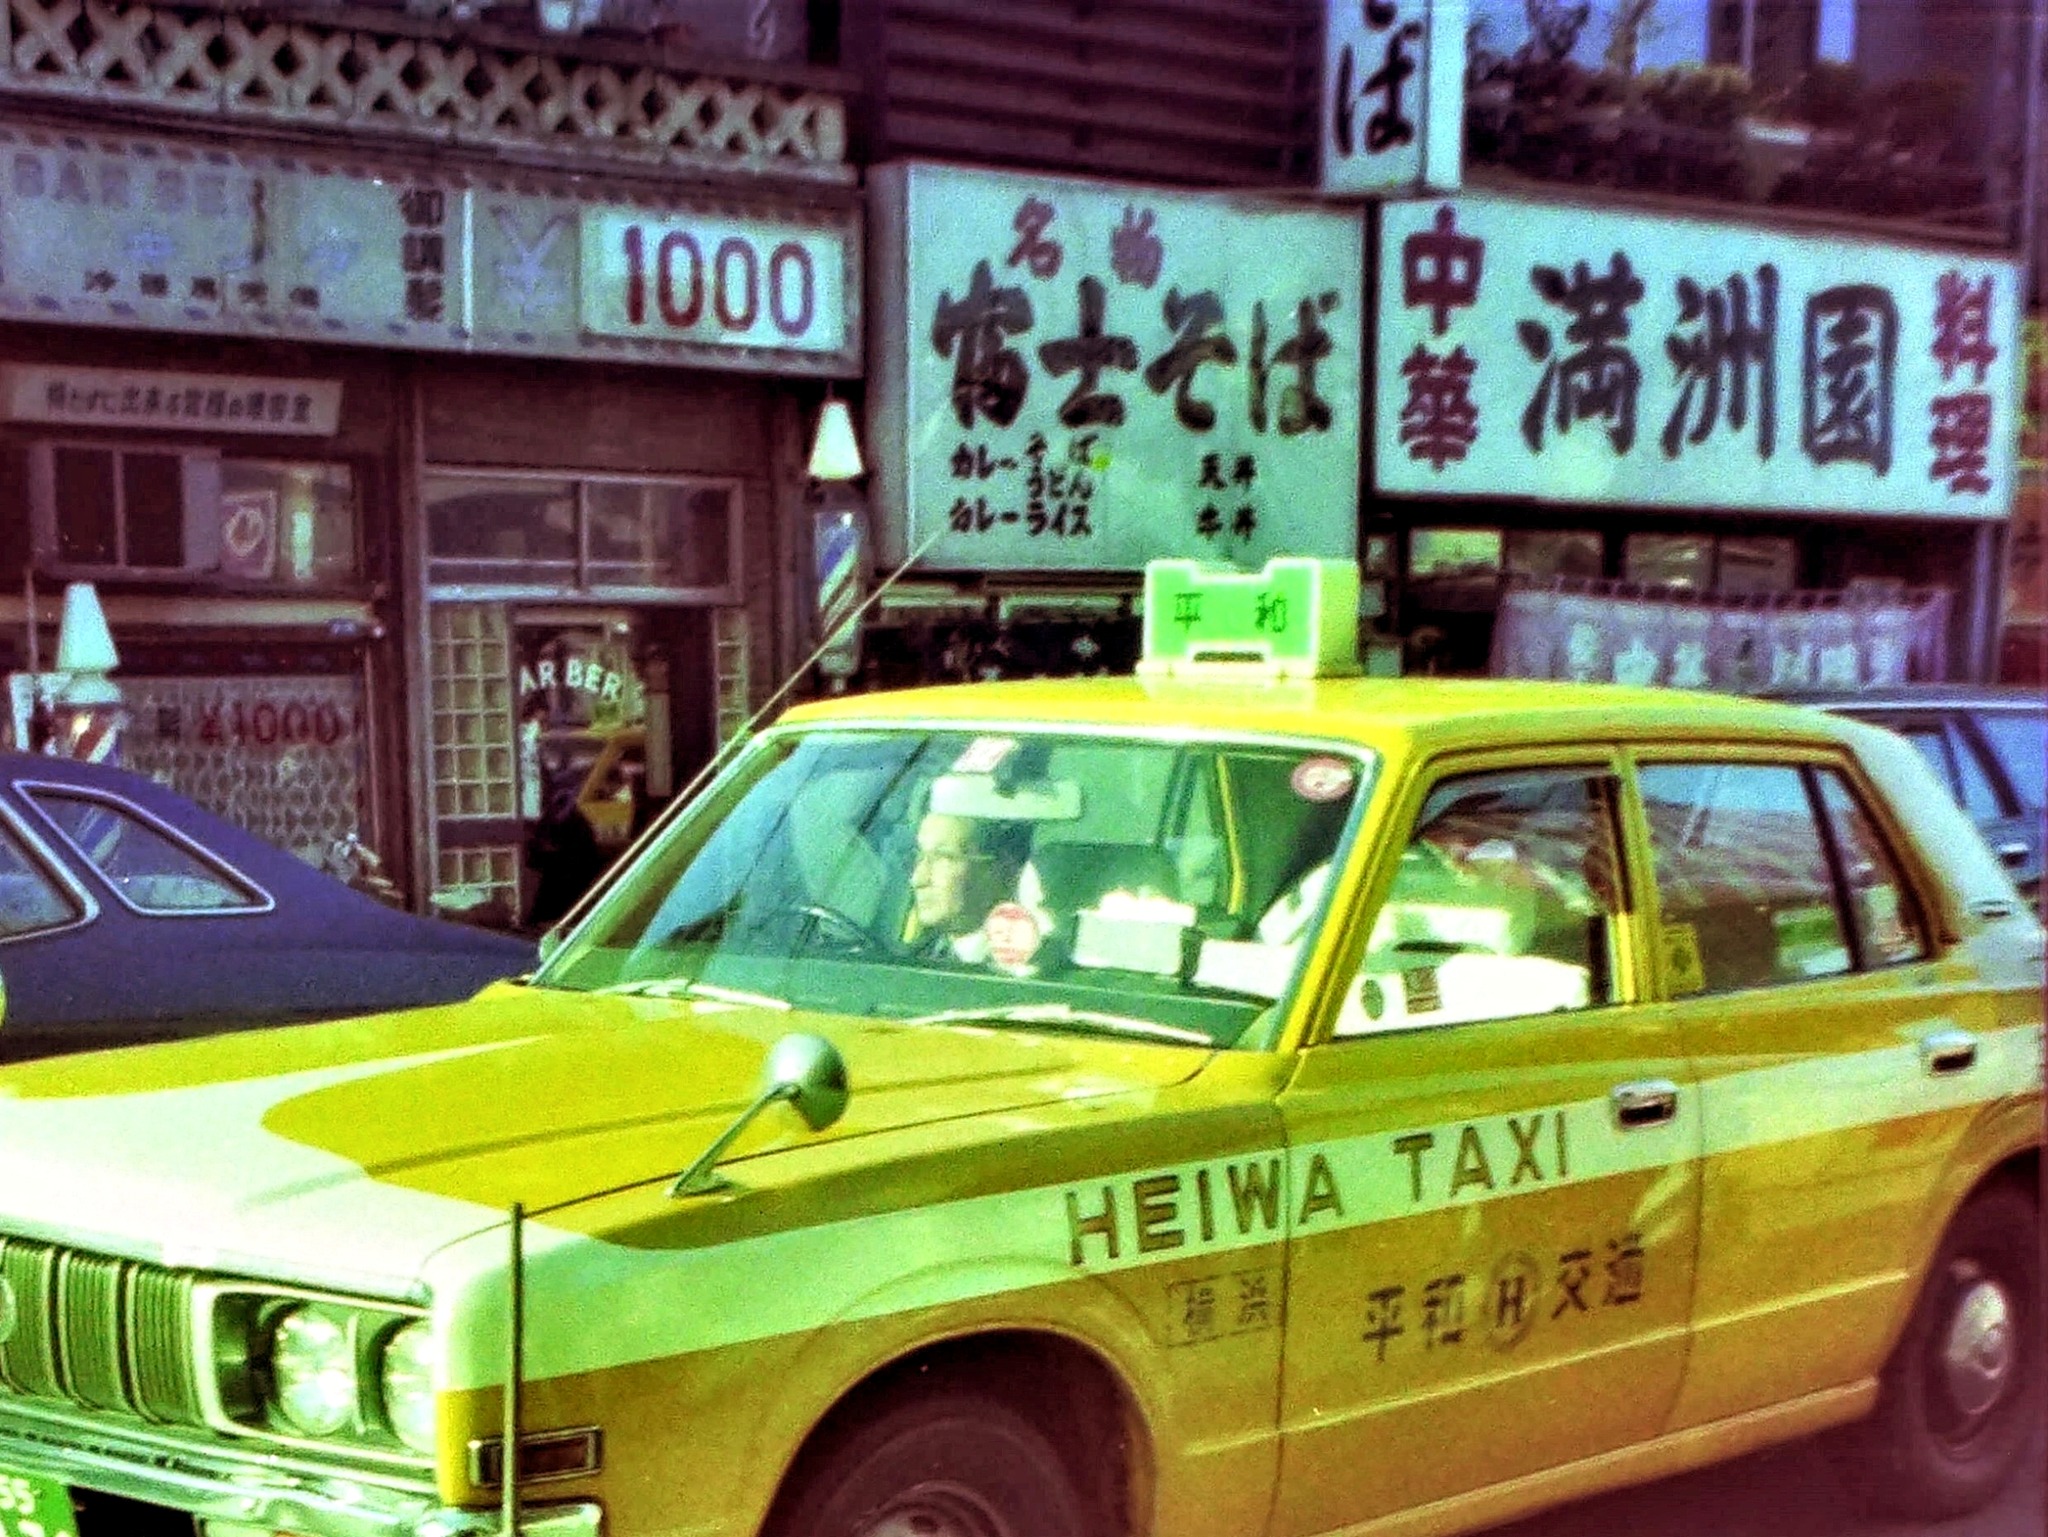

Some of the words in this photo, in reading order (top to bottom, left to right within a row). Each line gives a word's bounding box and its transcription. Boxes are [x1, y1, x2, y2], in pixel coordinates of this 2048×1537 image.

[625, 224, 814, 338] 1000
[932, 258, 1340, 438] 富士そば
[1400, 204, 1485, 471] 中華
[1516, 251, 1898, 477] 満洲園
[1930, 269, 1998, 496] 料理
[949, 496, 1093, 538] カレーライス
[1066, 1153, 1345, 1267] HEIWA
[1392, 1111, 1569, 1203] TAXI
